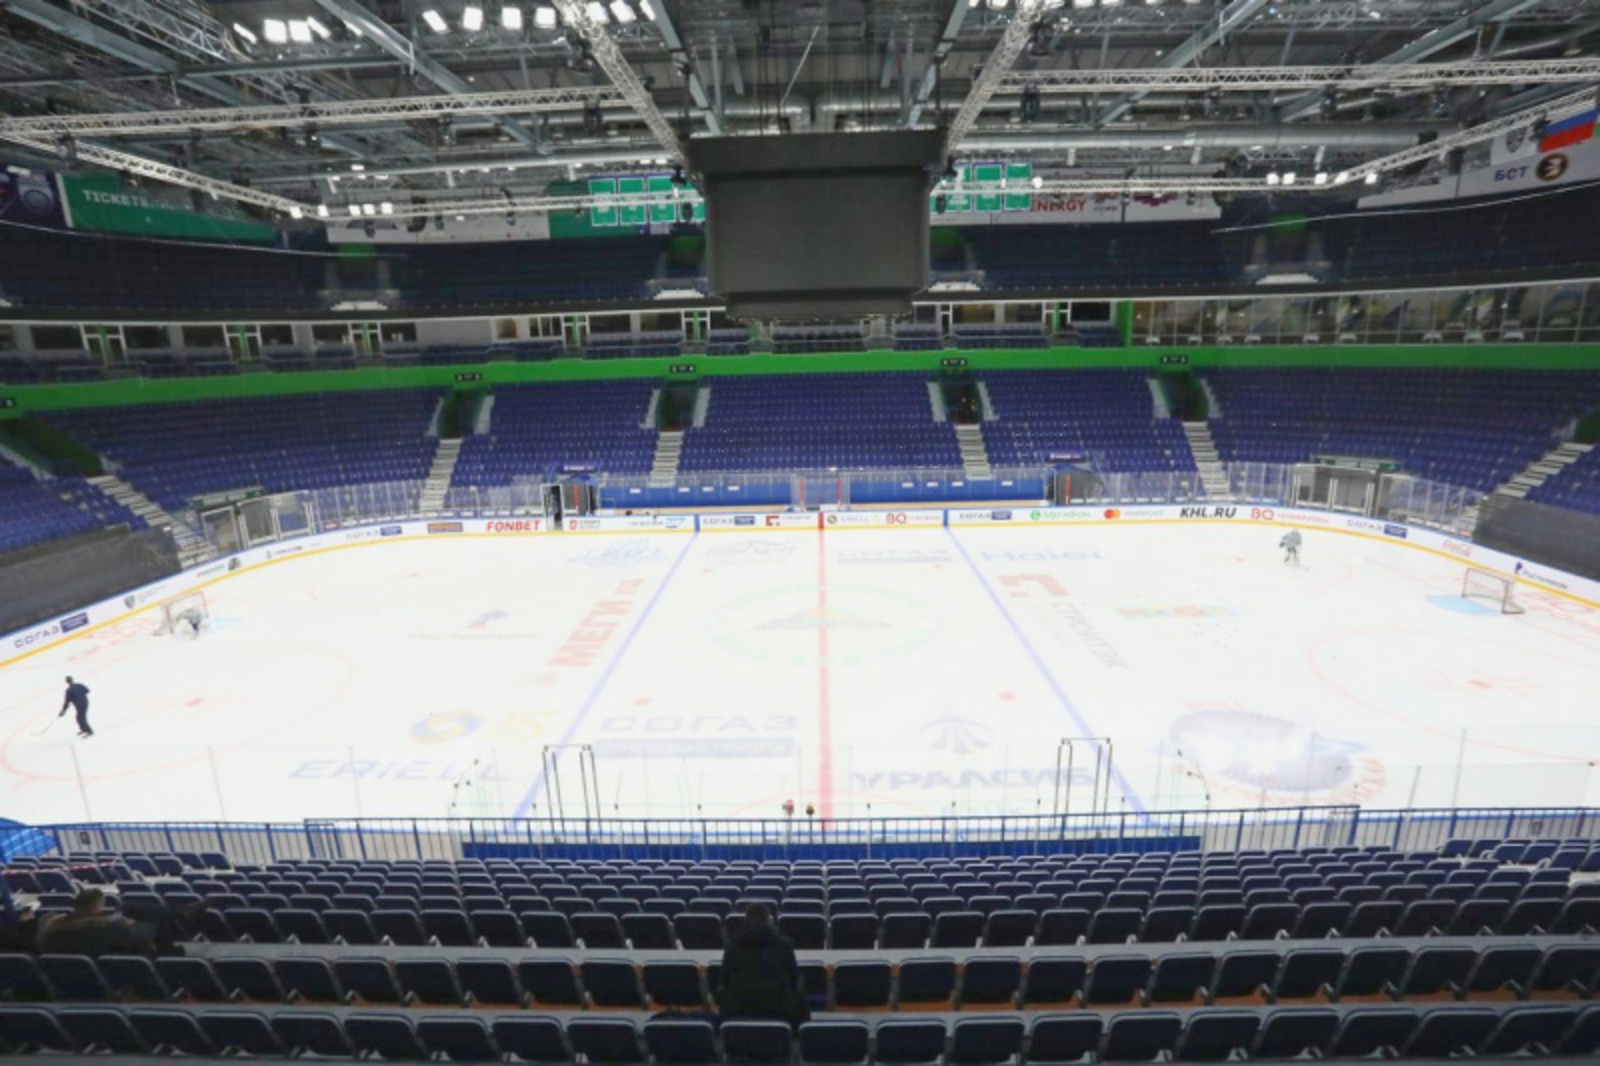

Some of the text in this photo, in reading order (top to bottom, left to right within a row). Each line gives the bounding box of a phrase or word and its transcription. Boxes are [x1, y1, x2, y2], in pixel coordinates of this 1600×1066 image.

[1493, 165, 1530, 182] БСТ
[1180, 507, 1237, 519] KHL.RU
[486, 519, 541, 532] FONBET
[13, 625, 61, 650] СОГАЗ
[600, 715, 799, 732] СОГАЗ
[288, 757, 511, 781] ERIELL
